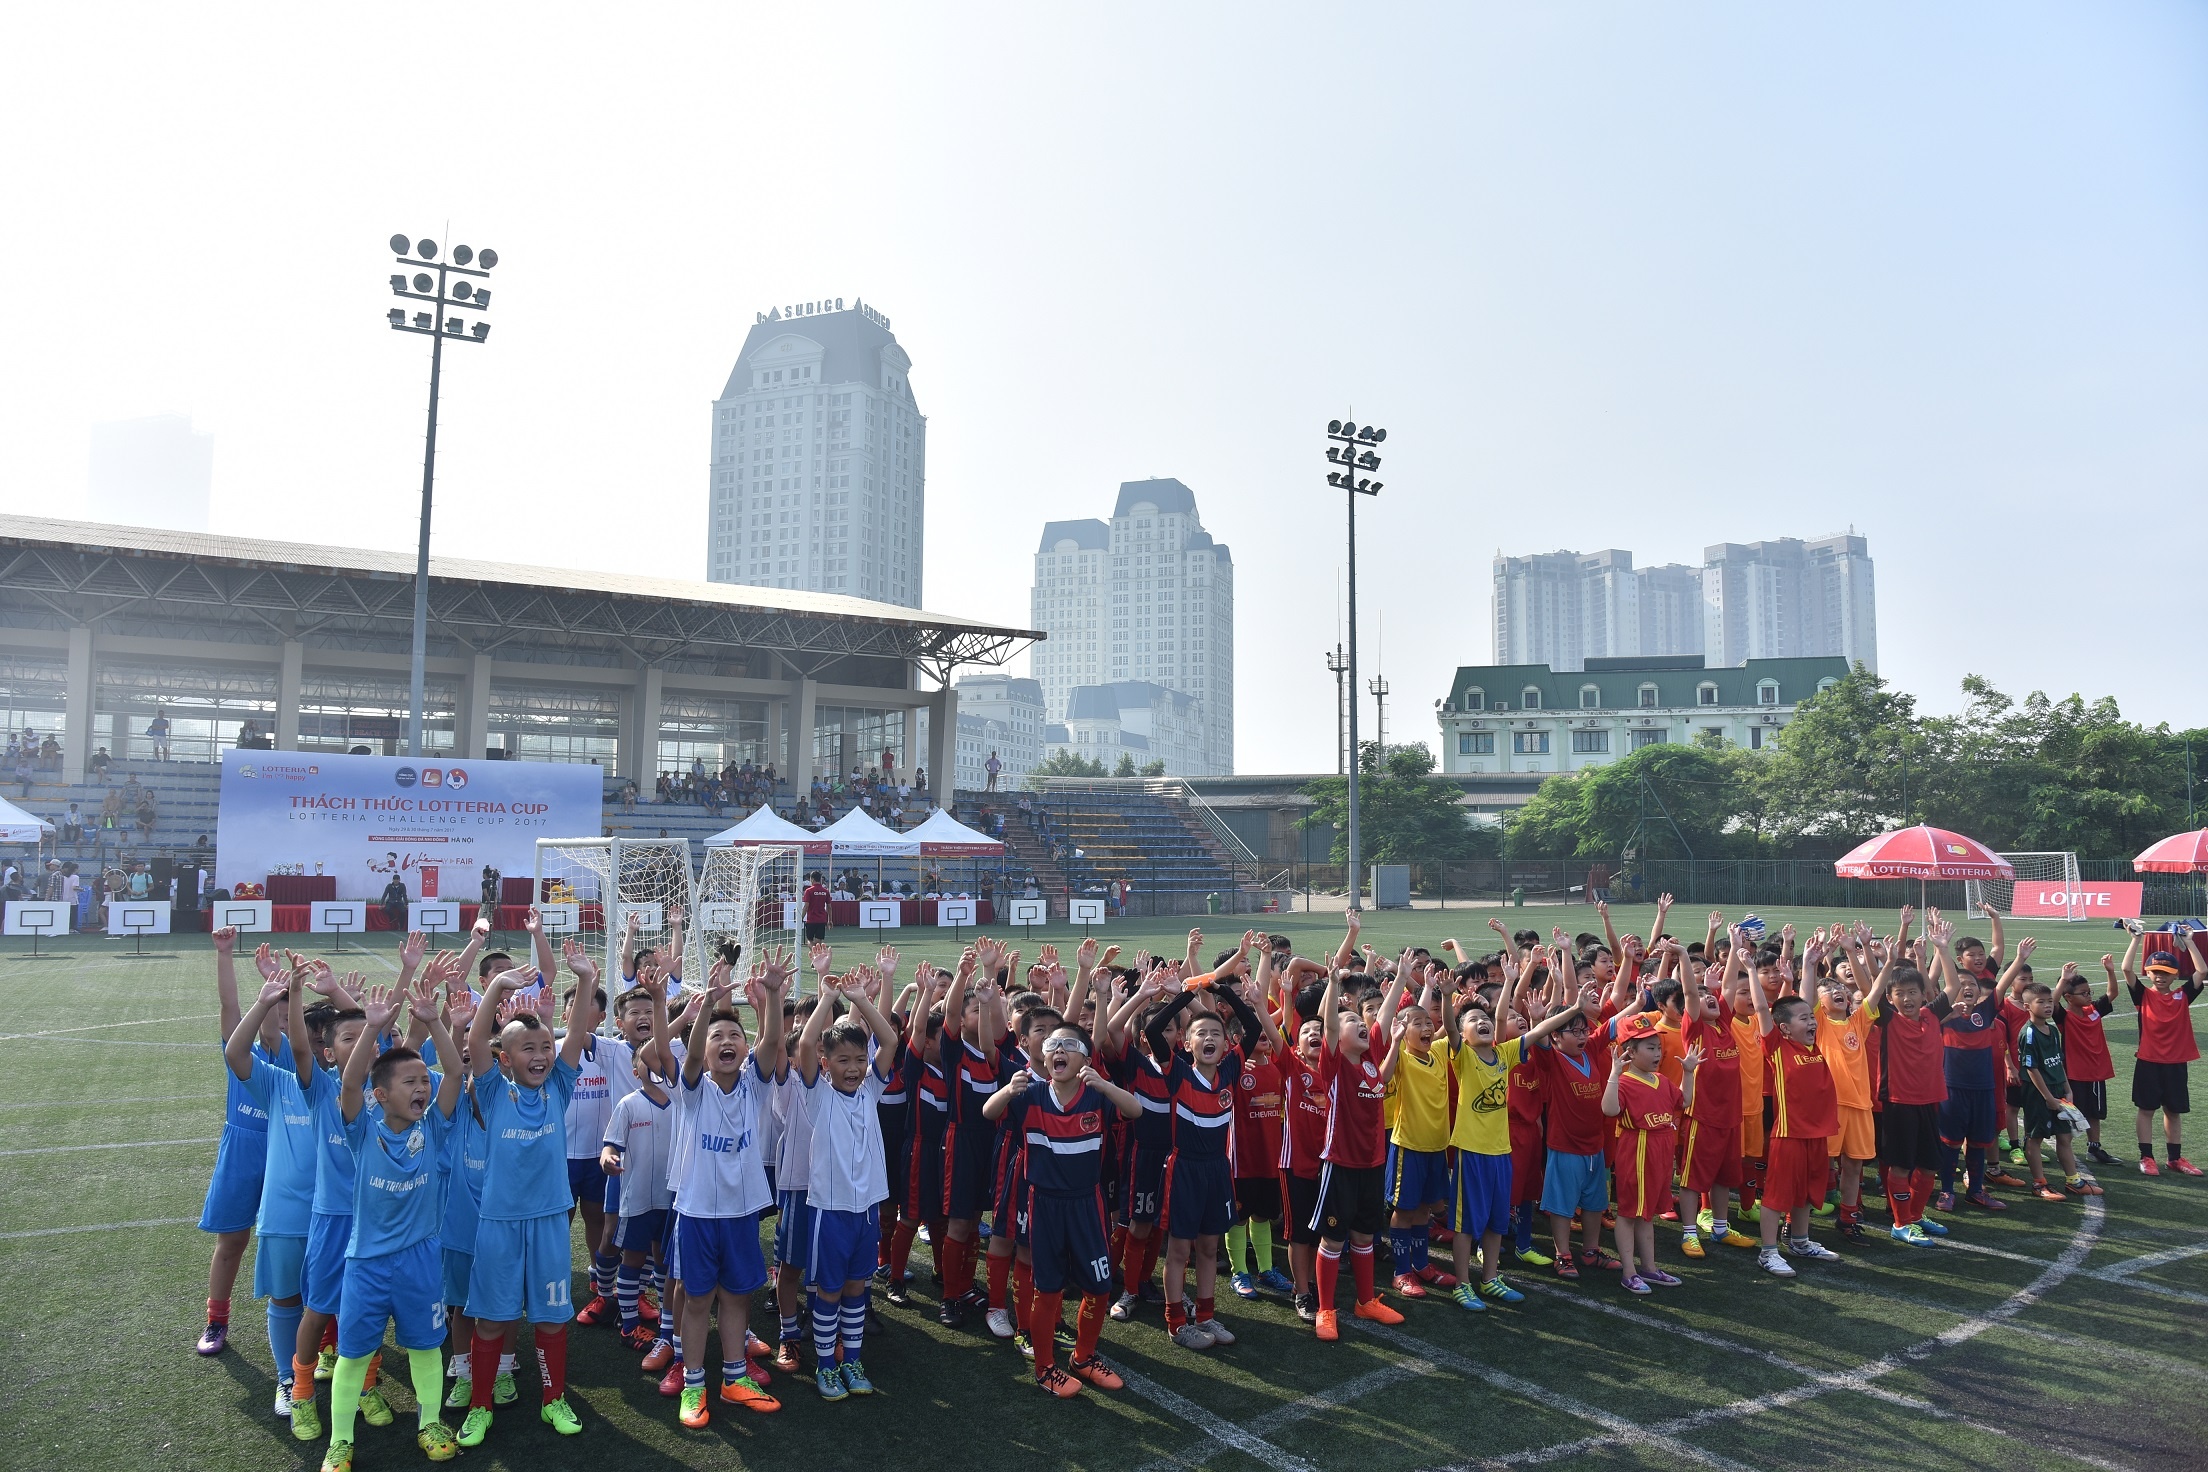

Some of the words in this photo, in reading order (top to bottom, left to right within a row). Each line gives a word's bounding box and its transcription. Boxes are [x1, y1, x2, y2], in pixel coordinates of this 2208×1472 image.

[289, 793, 356, 809] THÁCH
[361, 795, 414, 811] THỨC
[418, 799, 507, 814] LOTTERIA
[511, 802, 549, 815] CUP
[289, 812, 367, 822] LOTTERIA
[377, 813, 466, 824] CHALLENGE
[477, 817, 504, 825] CUP
[514, 818, 547, 826] 2017
[461, 836, 474, 844] NỘI
[1836, 866, 1865, 874] LOTTERIA
[1873, 866, 1929, 875] LOTTERIA
[1942, 867, 1992, 876] LOTTERIA
[2039, 892, 2111, 906] LOTTE
[591, 1089, 604, 1099] BLUE
[237, 1102, 251, 1116] LAM
[501, 1128, 517, 1139] LAM
[701, 1133, 734, 1153] BLUE
[369, 1175, 384, 1189] LAM
[414, 1173, 429, 1189] PHAT
[1135, 1192, 1154, 1214] 36
[1016, 1208, 1028, 1234] 4
[1090, 1255, 1110, 1283] 16
[545, 1278, 569, 1307] 11
